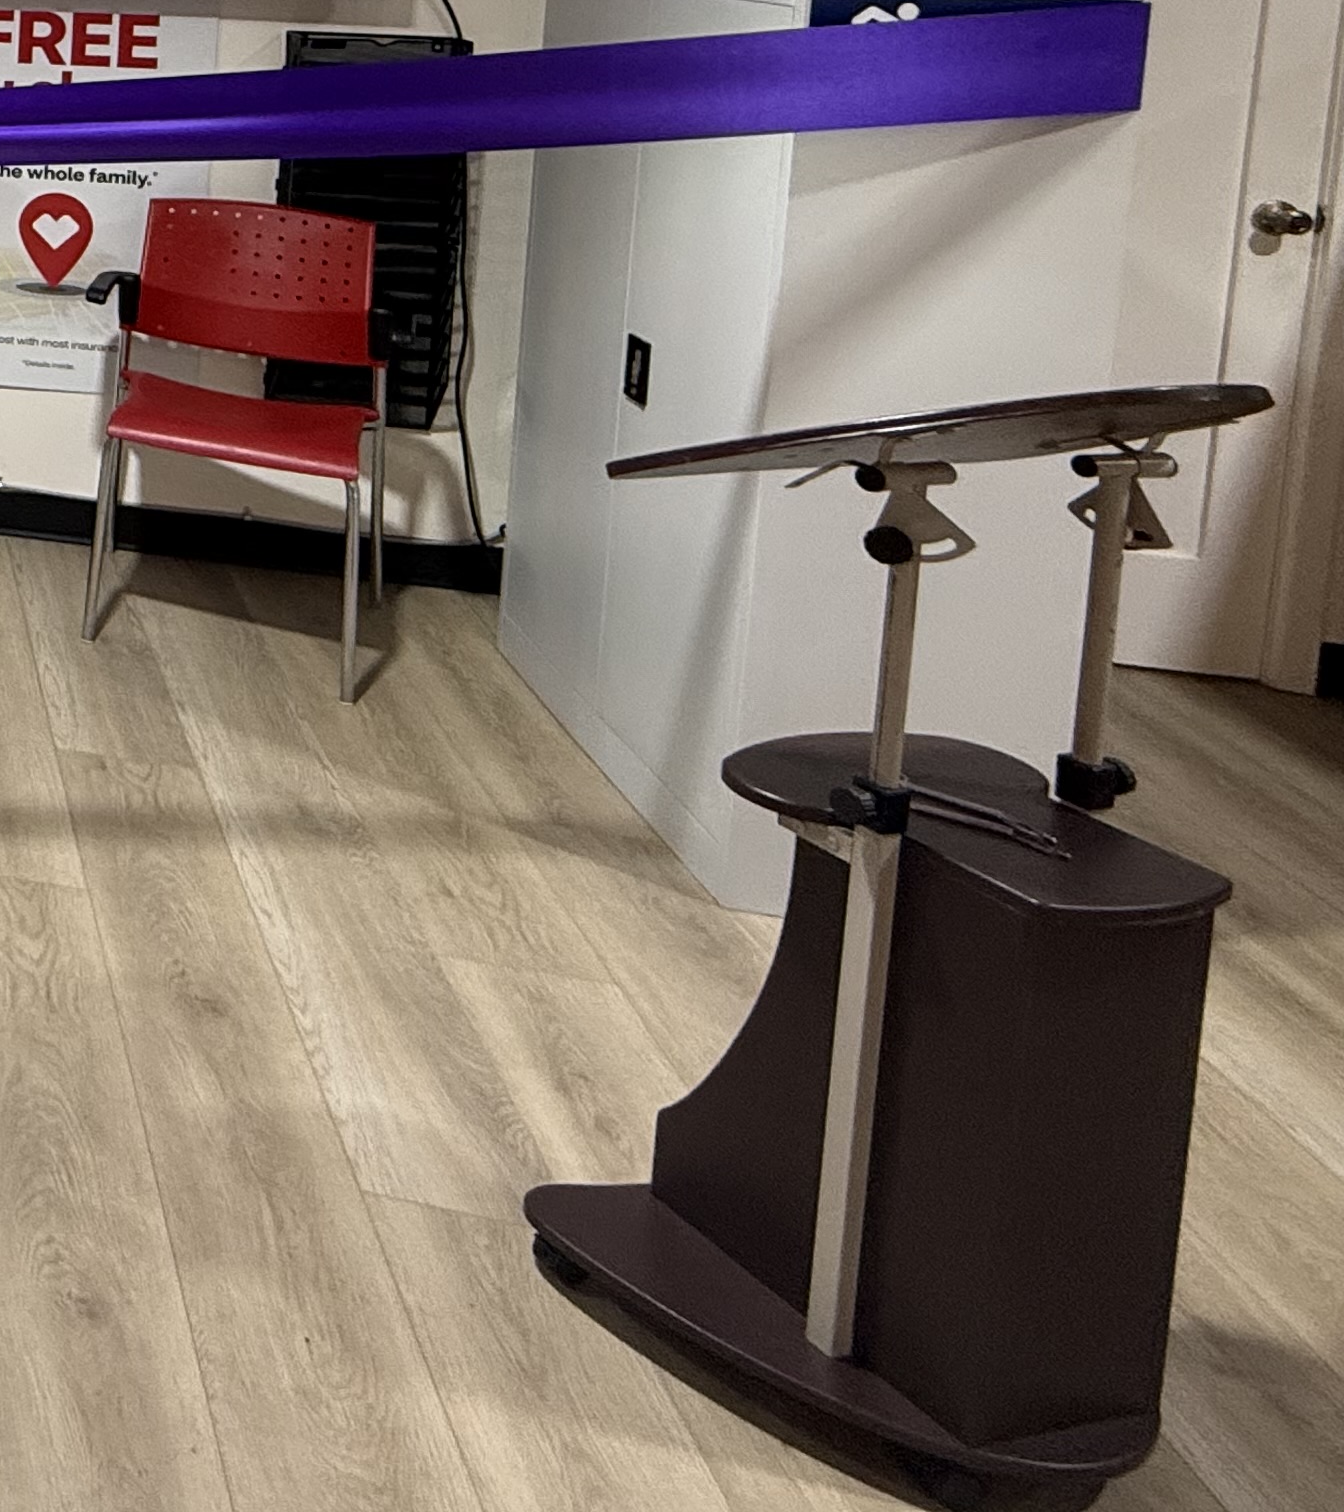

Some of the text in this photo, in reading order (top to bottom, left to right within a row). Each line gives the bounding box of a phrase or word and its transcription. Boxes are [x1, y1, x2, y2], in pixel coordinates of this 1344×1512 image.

[27, 165, 84, 182] whole
[17, 338, 39, 346] with
[41, 340, 69, 349] most
